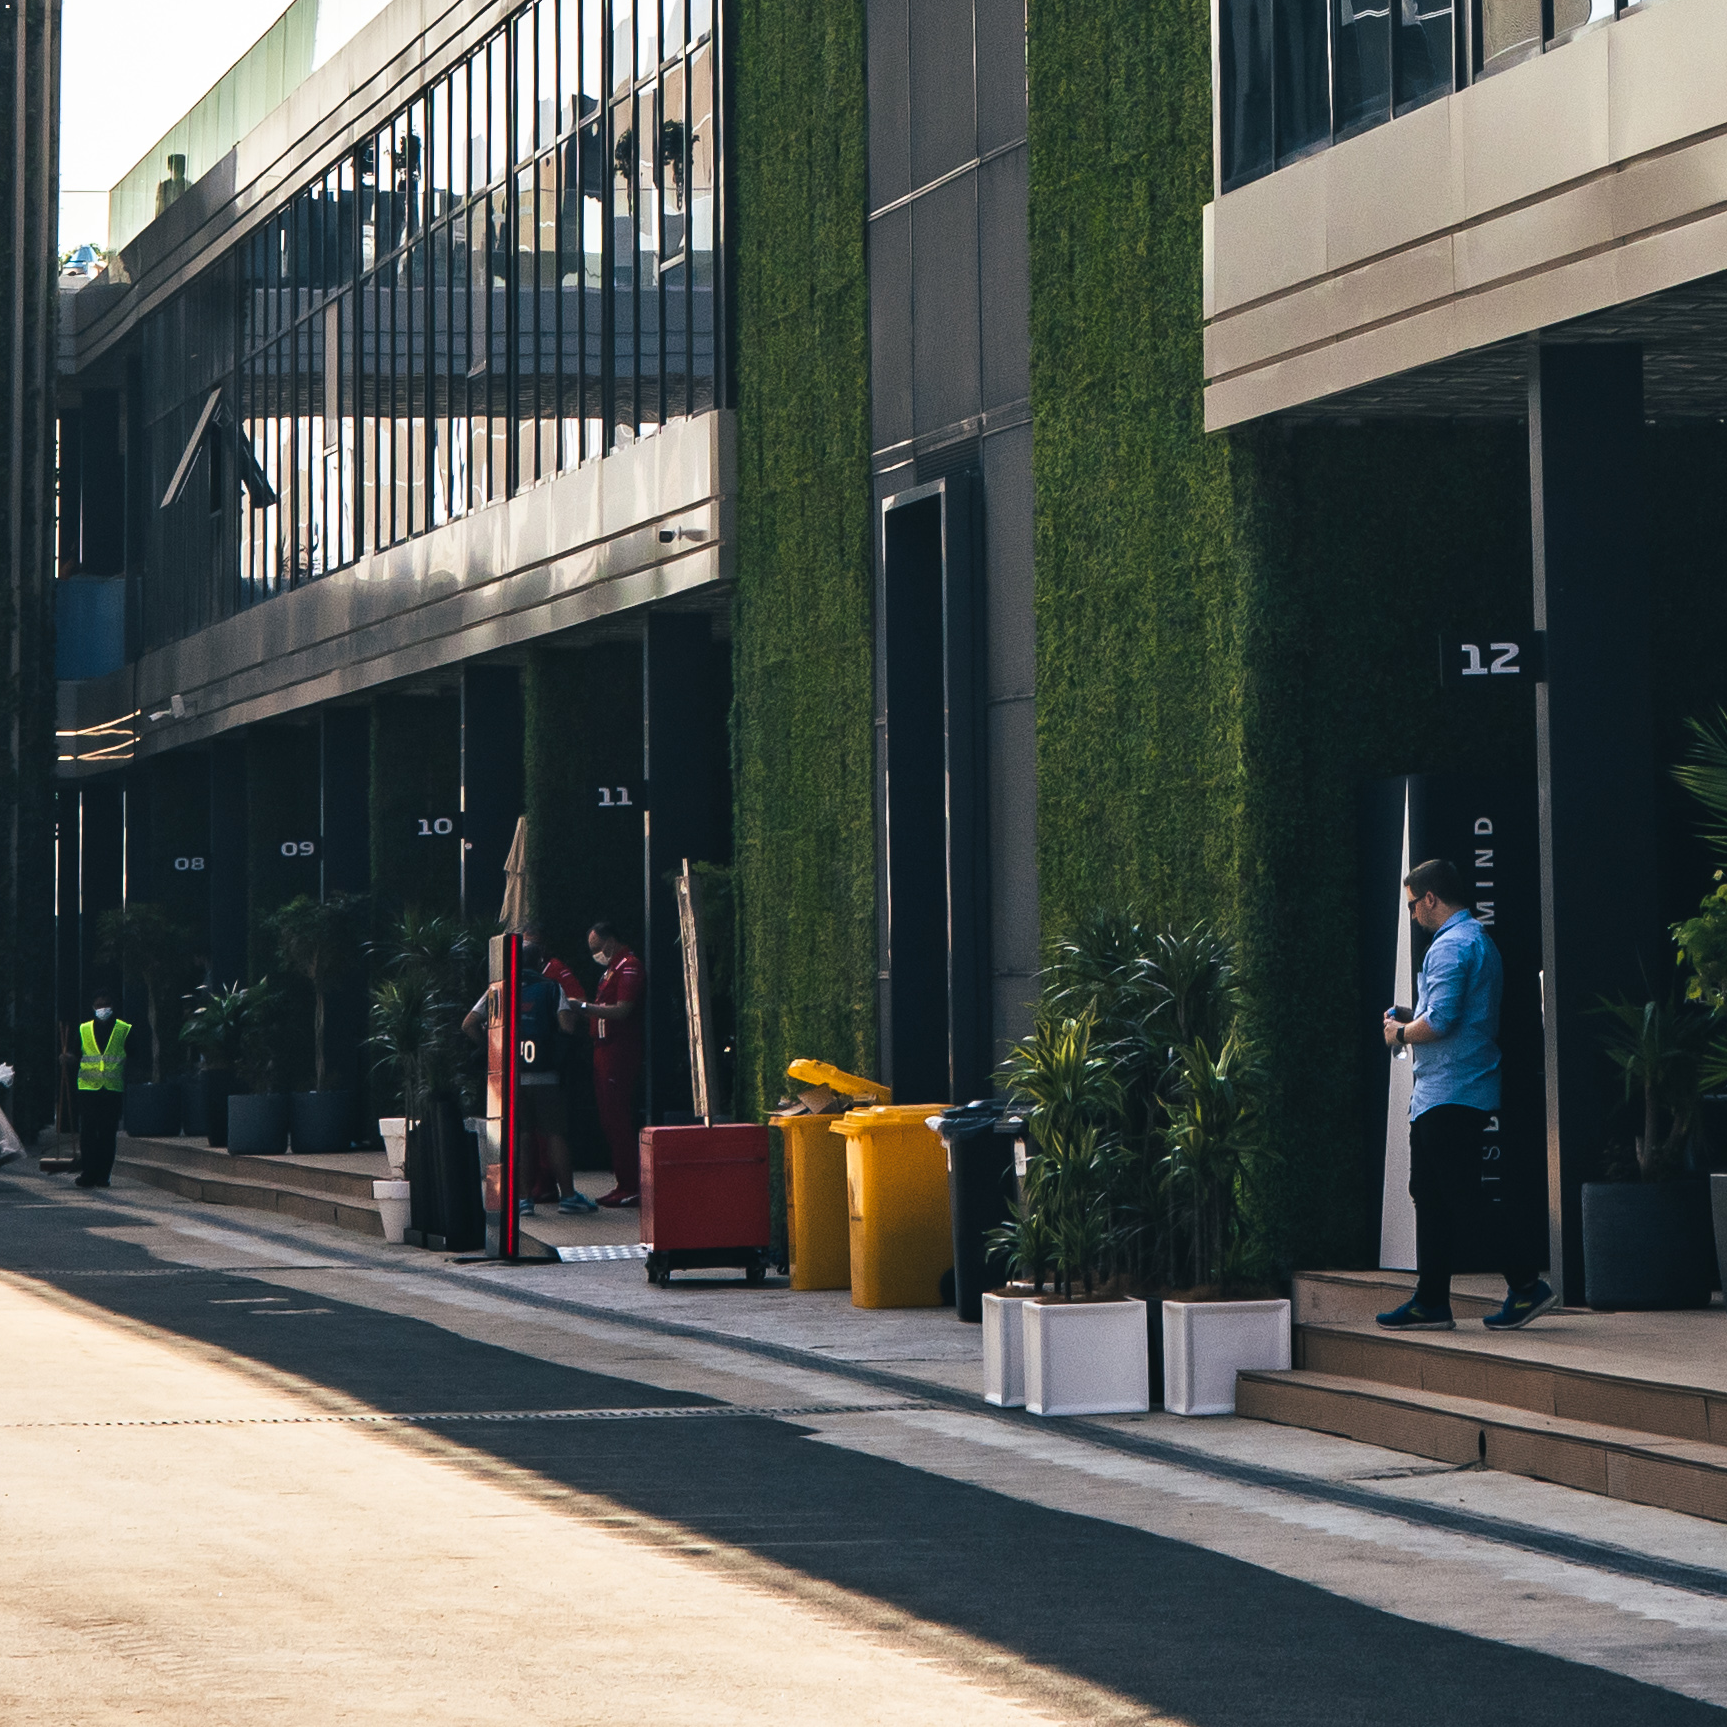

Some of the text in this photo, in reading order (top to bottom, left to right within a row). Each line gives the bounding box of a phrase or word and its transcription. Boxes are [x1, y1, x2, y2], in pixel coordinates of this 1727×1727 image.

[1461, 642, 1520, 675] 12
[598, 787, 633, 806] 11
[418, 817, 453, 836] 10
[281, 841, 315, 856] 09
[174, 857, 205, 871] 08
[1474, 817, 1495, 925] MIND
